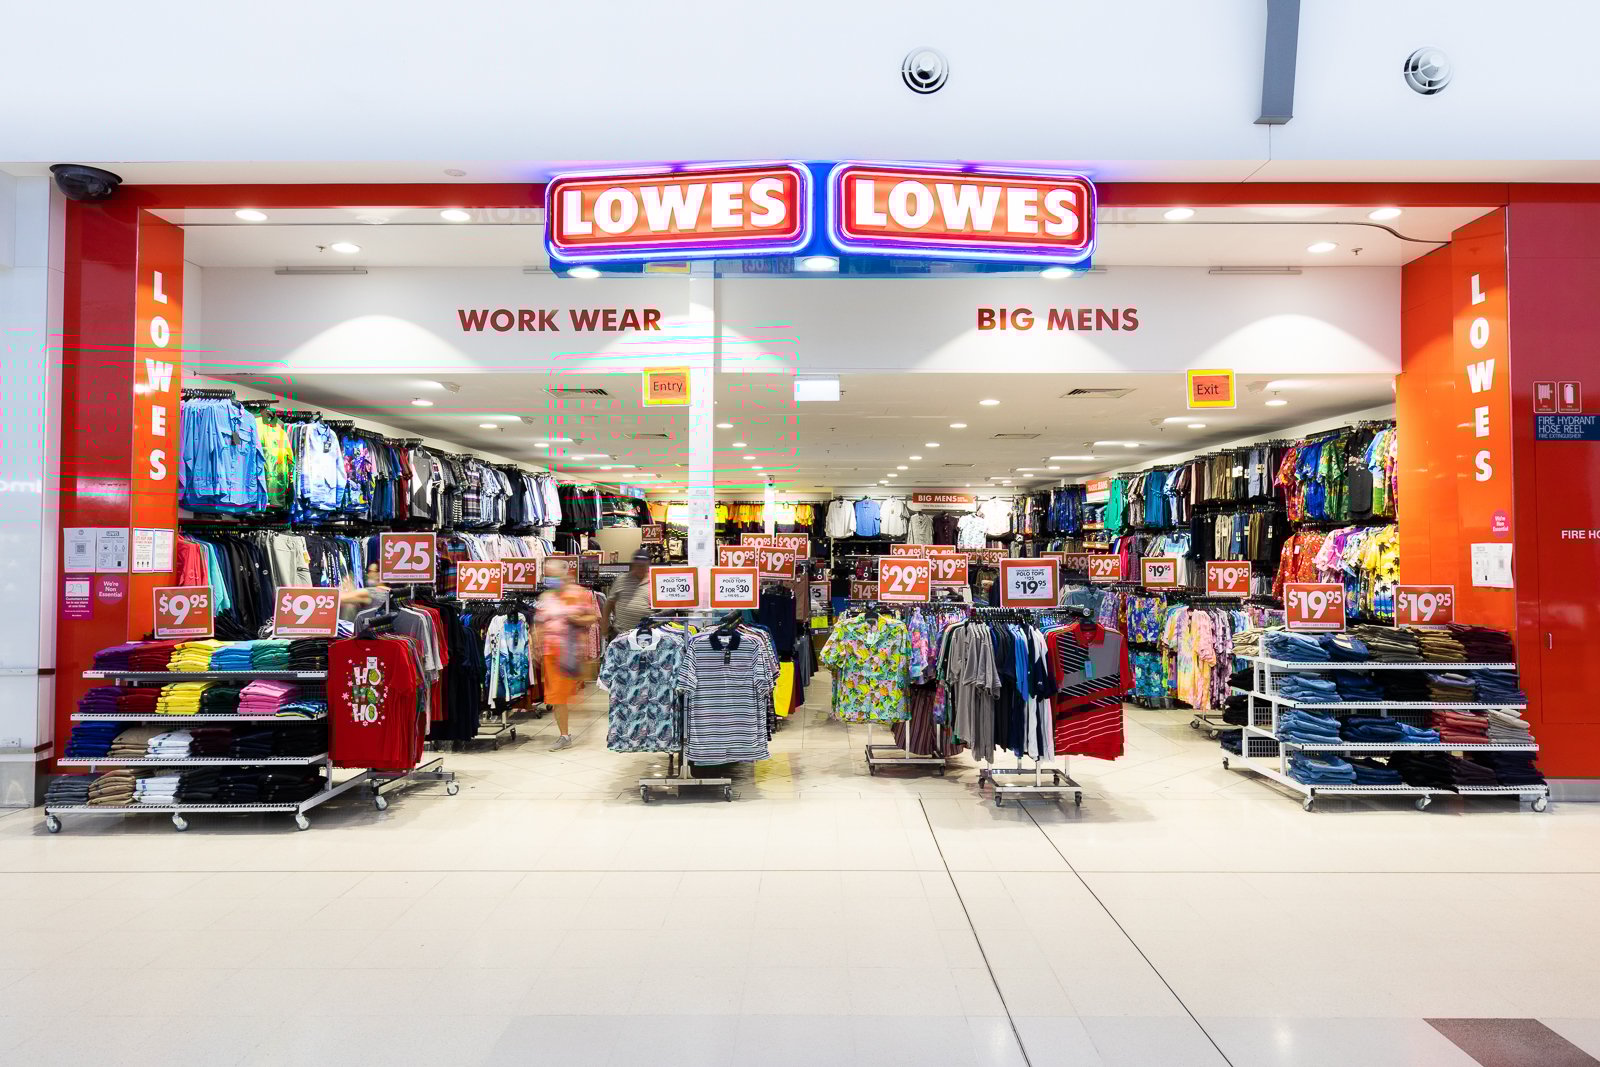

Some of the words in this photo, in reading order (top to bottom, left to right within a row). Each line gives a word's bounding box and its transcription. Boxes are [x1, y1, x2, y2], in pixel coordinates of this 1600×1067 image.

[562, 177, 787, 236] LOWES
[855, 178, 1079, 237] LOWES
[457, 309, 560, 332] WORK
[569, 309, 662, 332] WEAR
[977, 307, 1035, 332] BIG
[1046, 307, 1139, 332] MENS
[145, 270, 173, 480] LOWES
[1467, 273, 1495, 482] LOWES
[653, 380, 683, 394] Entry
[1197, 383, 1219, 395] Exit
[1538, 416, 1555, 425] FIRE
[1557, 416, 1596, 425] HYDRANT
[1538, 424, 1561, 434] HOSE
[1563, 424, 1584, 434] REEL
[917, 494, 932, 502] BIG
[934, 494, 957, 503] MENS
[1561, 529, 1586, 540] FIRE
[384, 539, 431, 571] $25
[660, 585, 666, 593] 2
[676, 584, 690, 593] $30
[719, 585, 725, 593] 2
[736, 584, 750, 593] $30
[352, 703, 378, 723] HO
